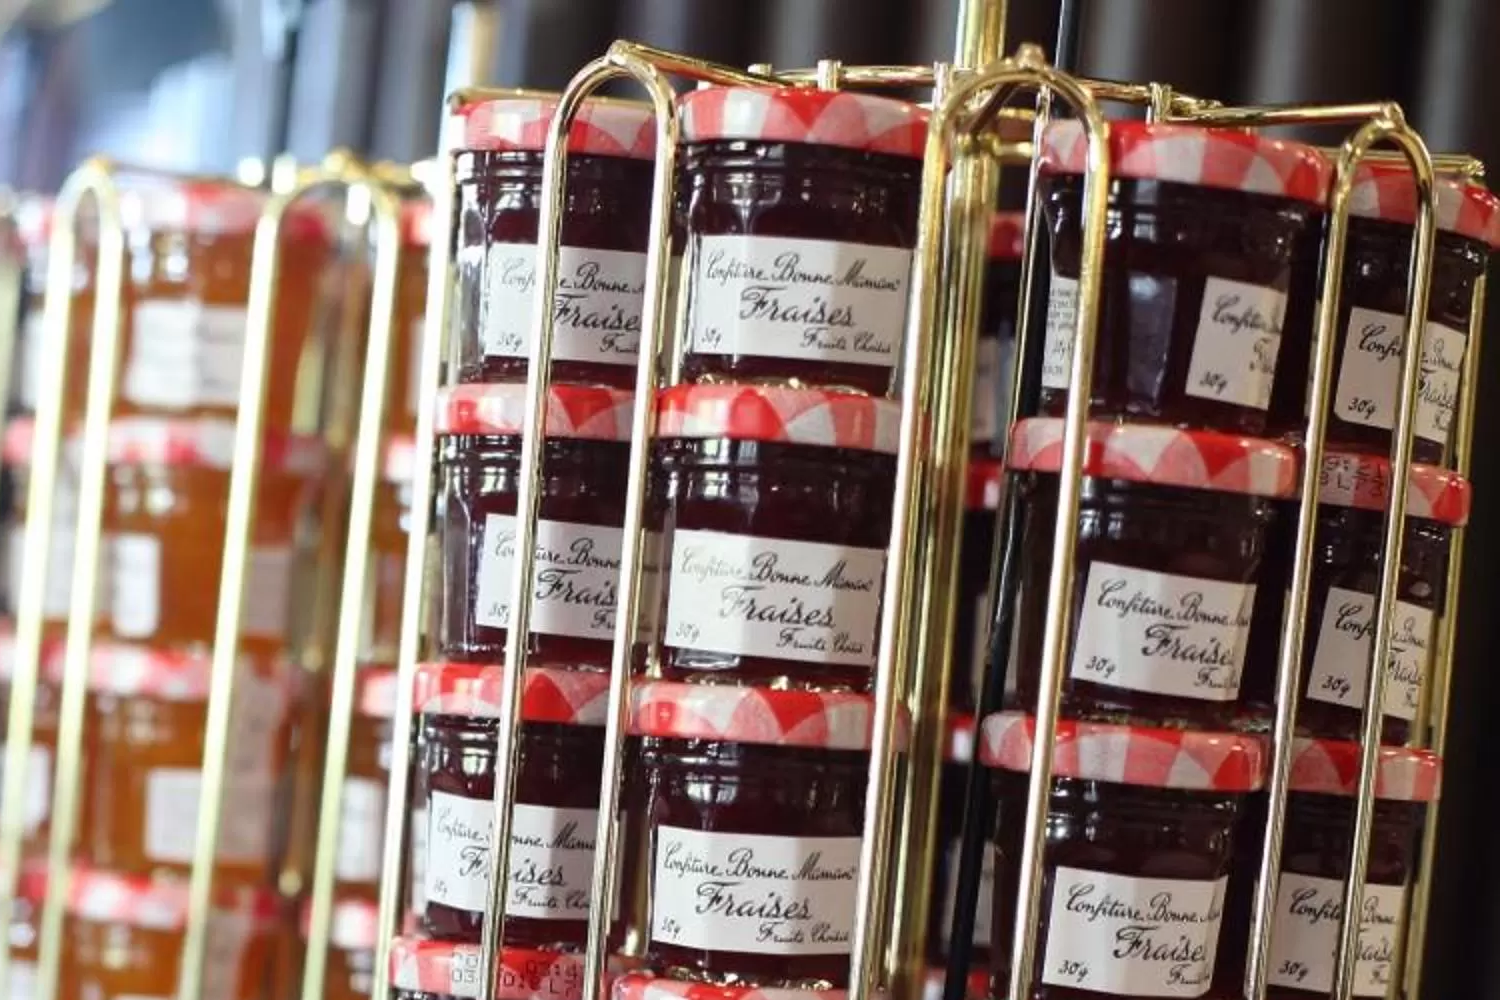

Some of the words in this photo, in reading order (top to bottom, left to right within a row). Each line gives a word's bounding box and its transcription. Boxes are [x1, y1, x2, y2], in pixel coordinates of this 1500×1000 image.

[770, 252, 832, 284] Bonne
[555, 293, 643, 331] Fraise
[740, 286, 855, 327] Fraises
[1347, 397, 1376, 420] 30g
[747, 552, 812, 588] Bonne
[719, 585, 837, 629] Fraises
[1097, 579, 1172, 619] Confiture
[1176, 591, 1229, 625] Bonne
[1084, 655, 1117, 679] 30g
[1321, 674, 1350, 698] 30g
[726, 848, 788, 881] Bonne
[695, 881, 813, 922] Fraises
[1066, 883, 1145, 922] Confiture
[1147, 892, 1198, 923] Bonne
[1057, 959, 1089, 983] 30g
[1278, 959, 1308, 982] 30g
